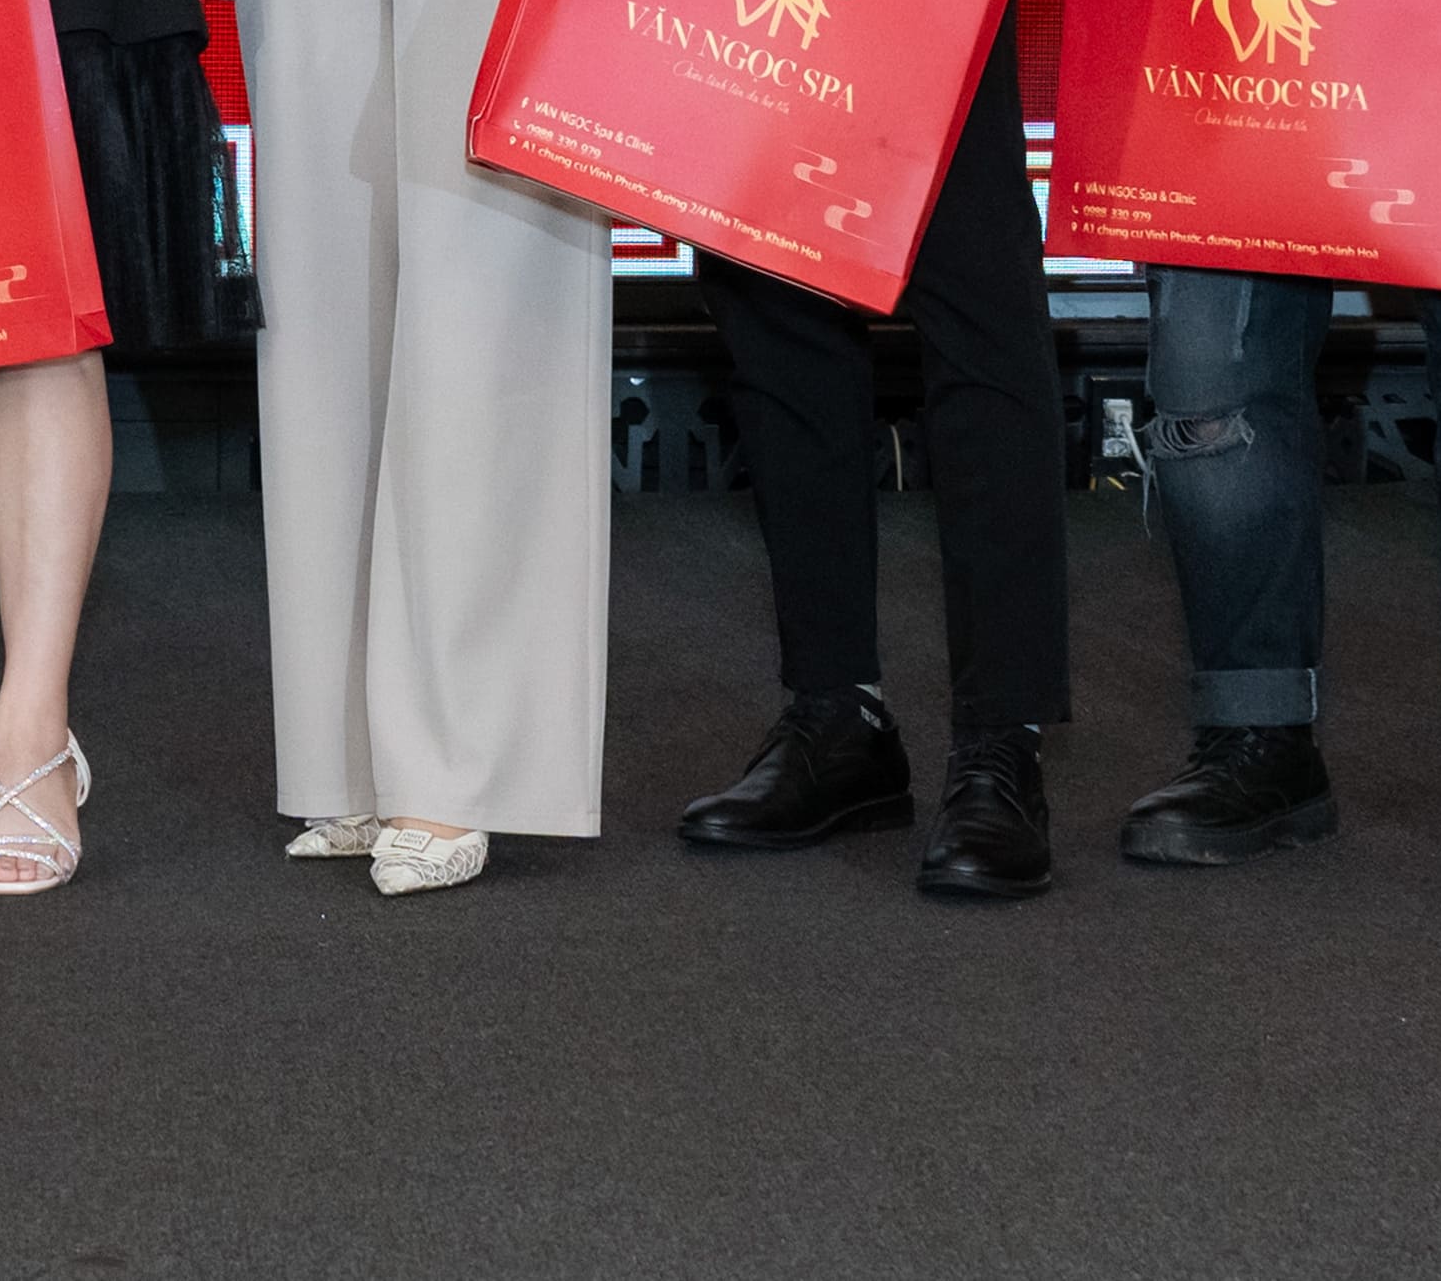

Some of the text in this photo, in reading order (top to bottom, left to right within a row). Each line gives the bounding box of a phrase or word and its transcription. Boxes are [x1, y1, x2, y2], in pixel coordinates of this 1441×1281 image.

[627, 0, 695, 49] VĂN
[698, 29, 797, 86] NGỌC
[798, 68, 853, 113] SPA
[1143, 64, 1367, 110] VĂN NGỌC SPA
[592, 122, 614, 140] Spa
[613, 130, 624, 144] &
[624, 134, 655, 156] Clinic
[521, 139, 536, 152] A1
[537, 146, 572, 169] chung
[688, 201, 708, 217] 2/4
[708, 208, 731, 226] Nha
[1138, 187, 1157, 202] Spa
[1158, 190, 1167, 202] &
[1168, 190, 1196, 205] Clinic
[1082, 221, 1095, 233] A1
[1096, 223, 1129, 239] chung
[1244, 236, 1261, 248] 2/4
[1262, 238, 1285, 250] Nha
